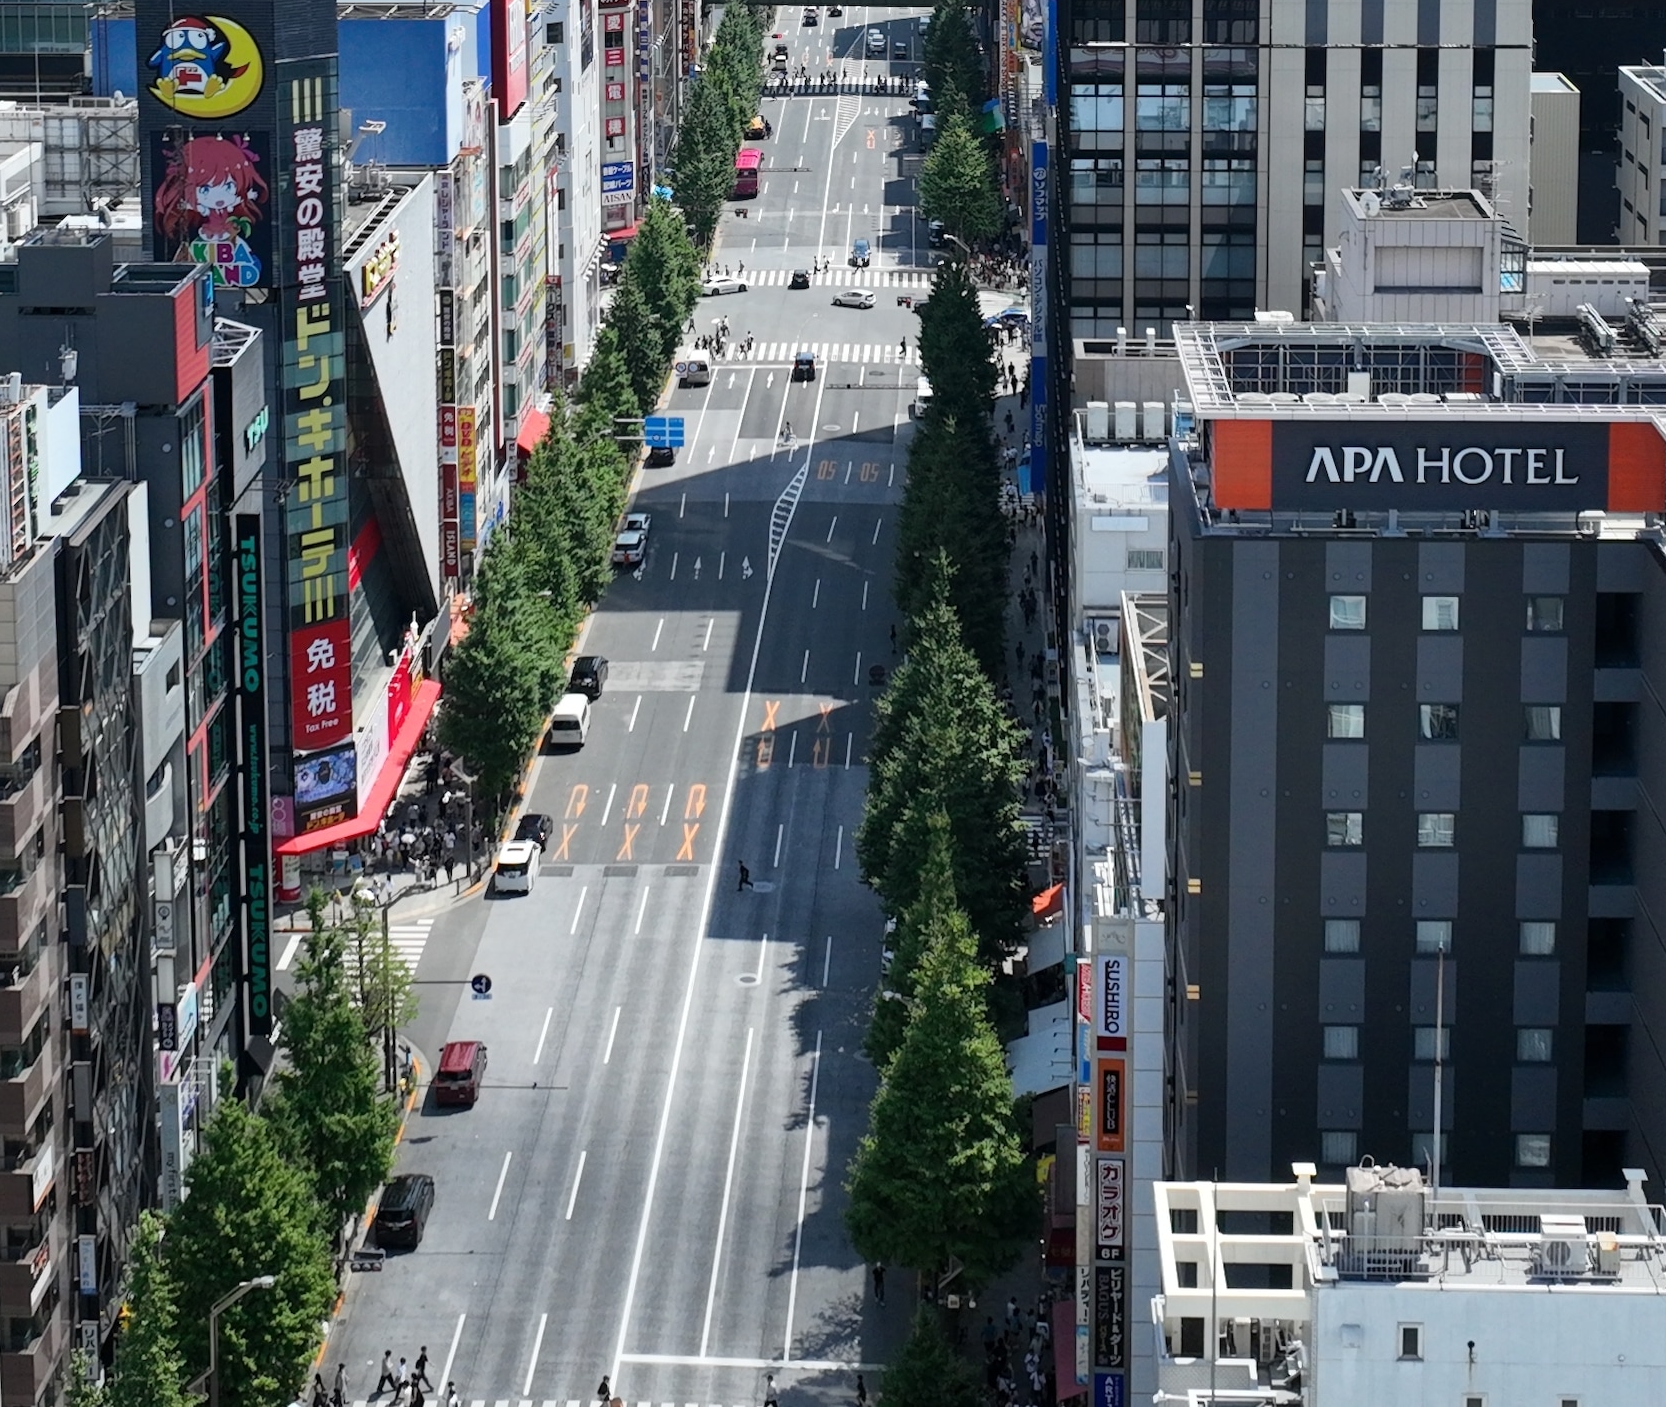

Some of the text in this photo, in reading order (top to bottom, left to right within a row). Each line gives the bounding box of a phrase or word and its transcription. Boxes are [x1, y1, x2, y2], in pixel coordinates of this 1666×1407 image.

[607, 15, 623, 135] 愛三電機
[294, 127, 326, 301] 驚安の殿堂
[603, 192, 632, 204] AISAN
[296, 302, 334, 578] ドン・キホーテ
[1034, 403, 1046, 448] Sofmap
[1305, 446, 1580, 485] APA HOTEL
[446, 530, 456, 566] ISLAND
[241, 535, 260, 693] TSUKUMO
[306, 638, 336, 718] 免税
[305, 718, 339, 734] Tax Free
[249, 724, 263, 834] www.tsukumo.co.jp
[249, 863, 268, 1018] TSUKUMO
[1107, 959, 1120, 1034] SUSHIRO
[1100, 1162, 1120, 1241] カラオケ
[1101, 1248, 1119, 1259] 6F
[1098, 1274, 1109, 1319] BAGUS
[1110, 1269, 1122, 1366] ビリヤード&ダーツ
